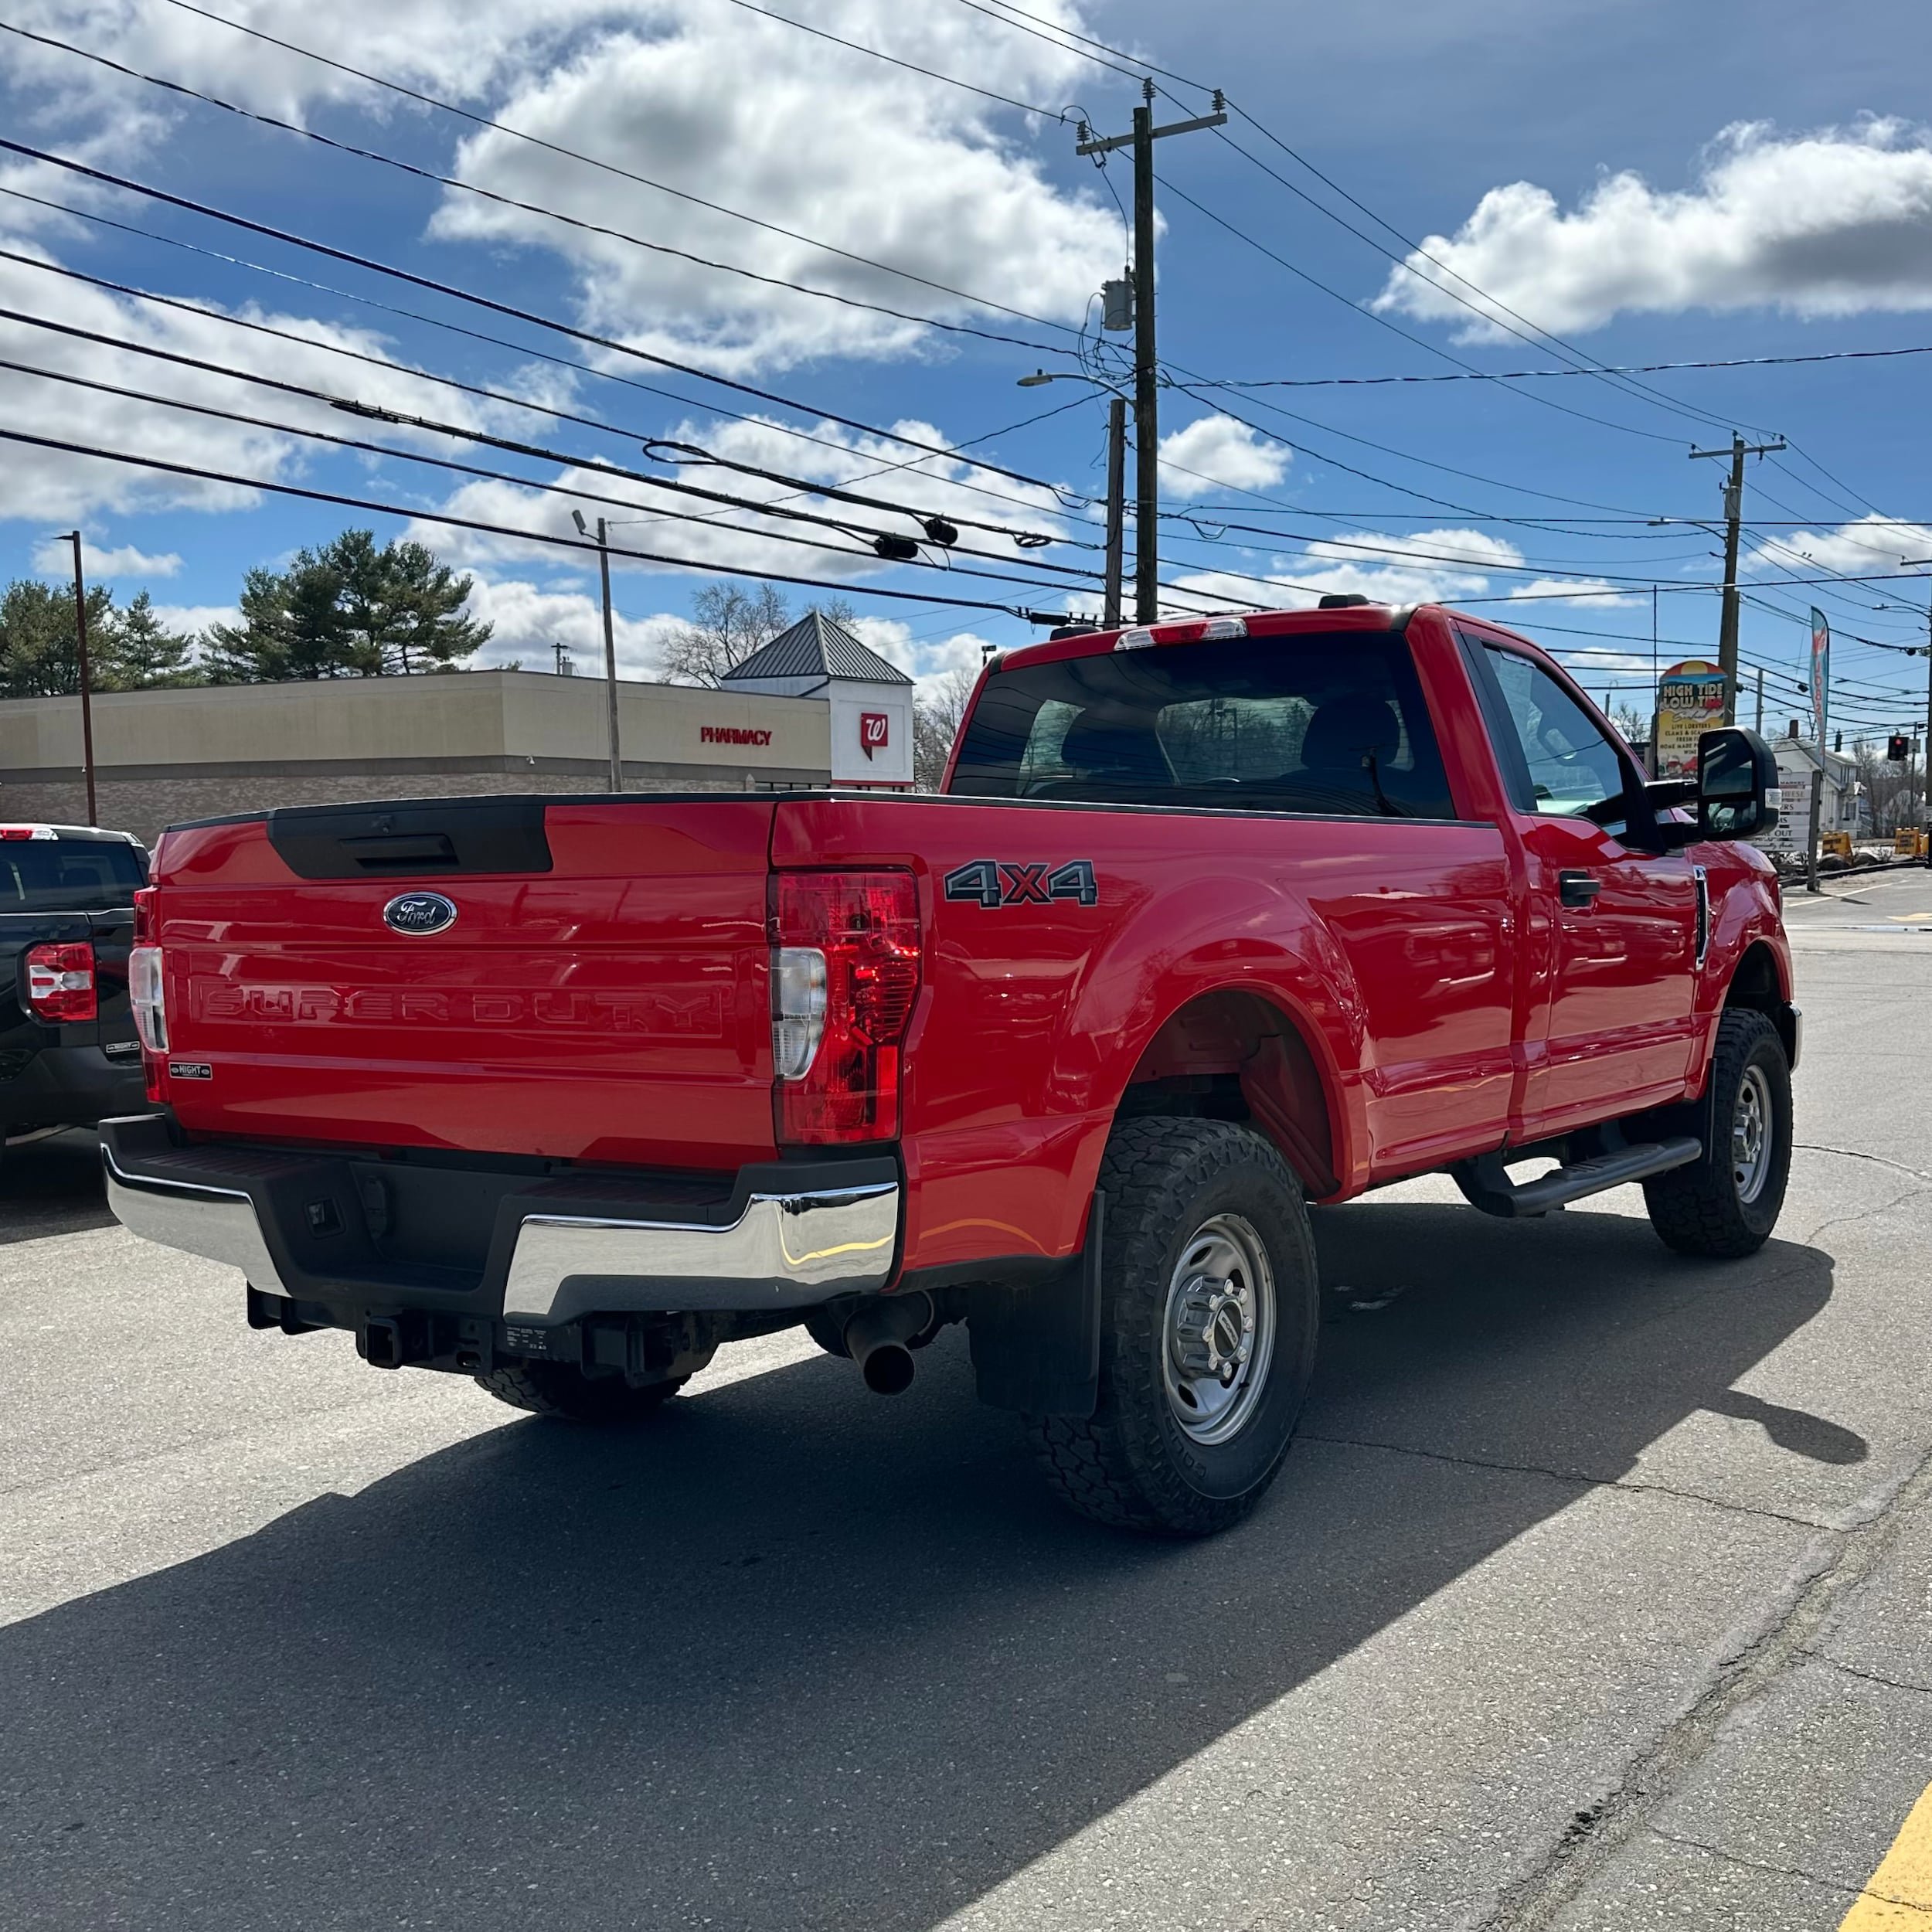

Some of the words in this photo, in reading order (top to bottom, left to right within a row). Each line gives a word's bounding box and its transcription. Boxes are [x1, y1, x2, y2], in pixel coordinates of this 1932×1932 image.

[1663, 685, 1693, 697] HIGH
[1697, 683, 1723, 696] TIDE
[1663, 696, 1694, 709] LOW
[700, 726, 773, 747] PHARMACY
[396, 900, 437, 925] Ford
[208, 988, 449, 1021] SUPER
[472, 992, 713, 1028] DUTY
[179, 1065, 202, 1075] HIGHT
